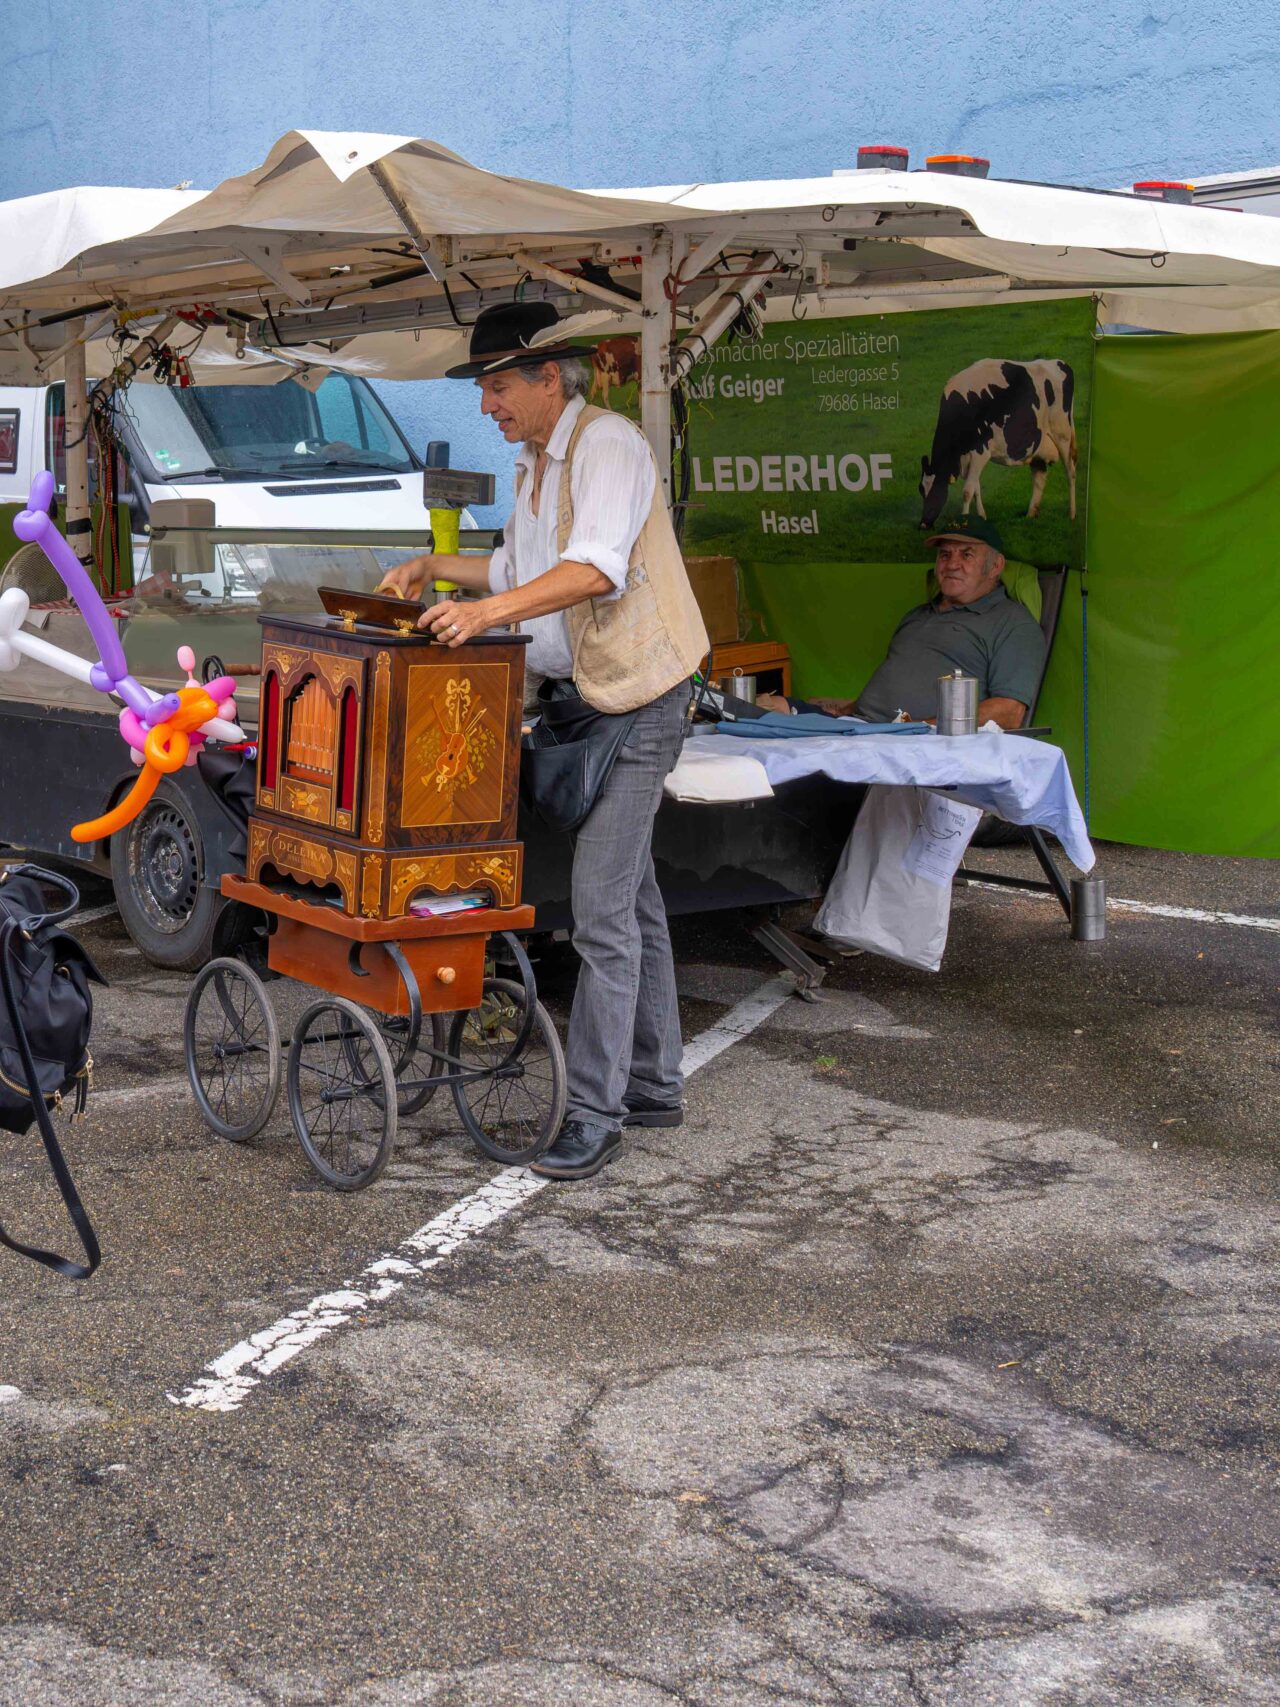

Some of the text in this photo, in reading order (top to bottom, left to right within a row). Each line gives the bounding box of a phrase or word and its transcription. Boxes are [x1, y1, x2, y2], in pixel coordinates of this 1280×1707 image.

[696, 330, 899, 365] smacher Spezialitäten
[811, 363, 899, 386] Ledergasse 5
[719, 373, 785, 403] Geiger
[817, 391, 899, 412] 79686 Hasel
[692, 453, 893, 493] LEDERHOF
[761, 509, 819, 535] Hasel
[279, 840, 325, 863] DELEIKA
